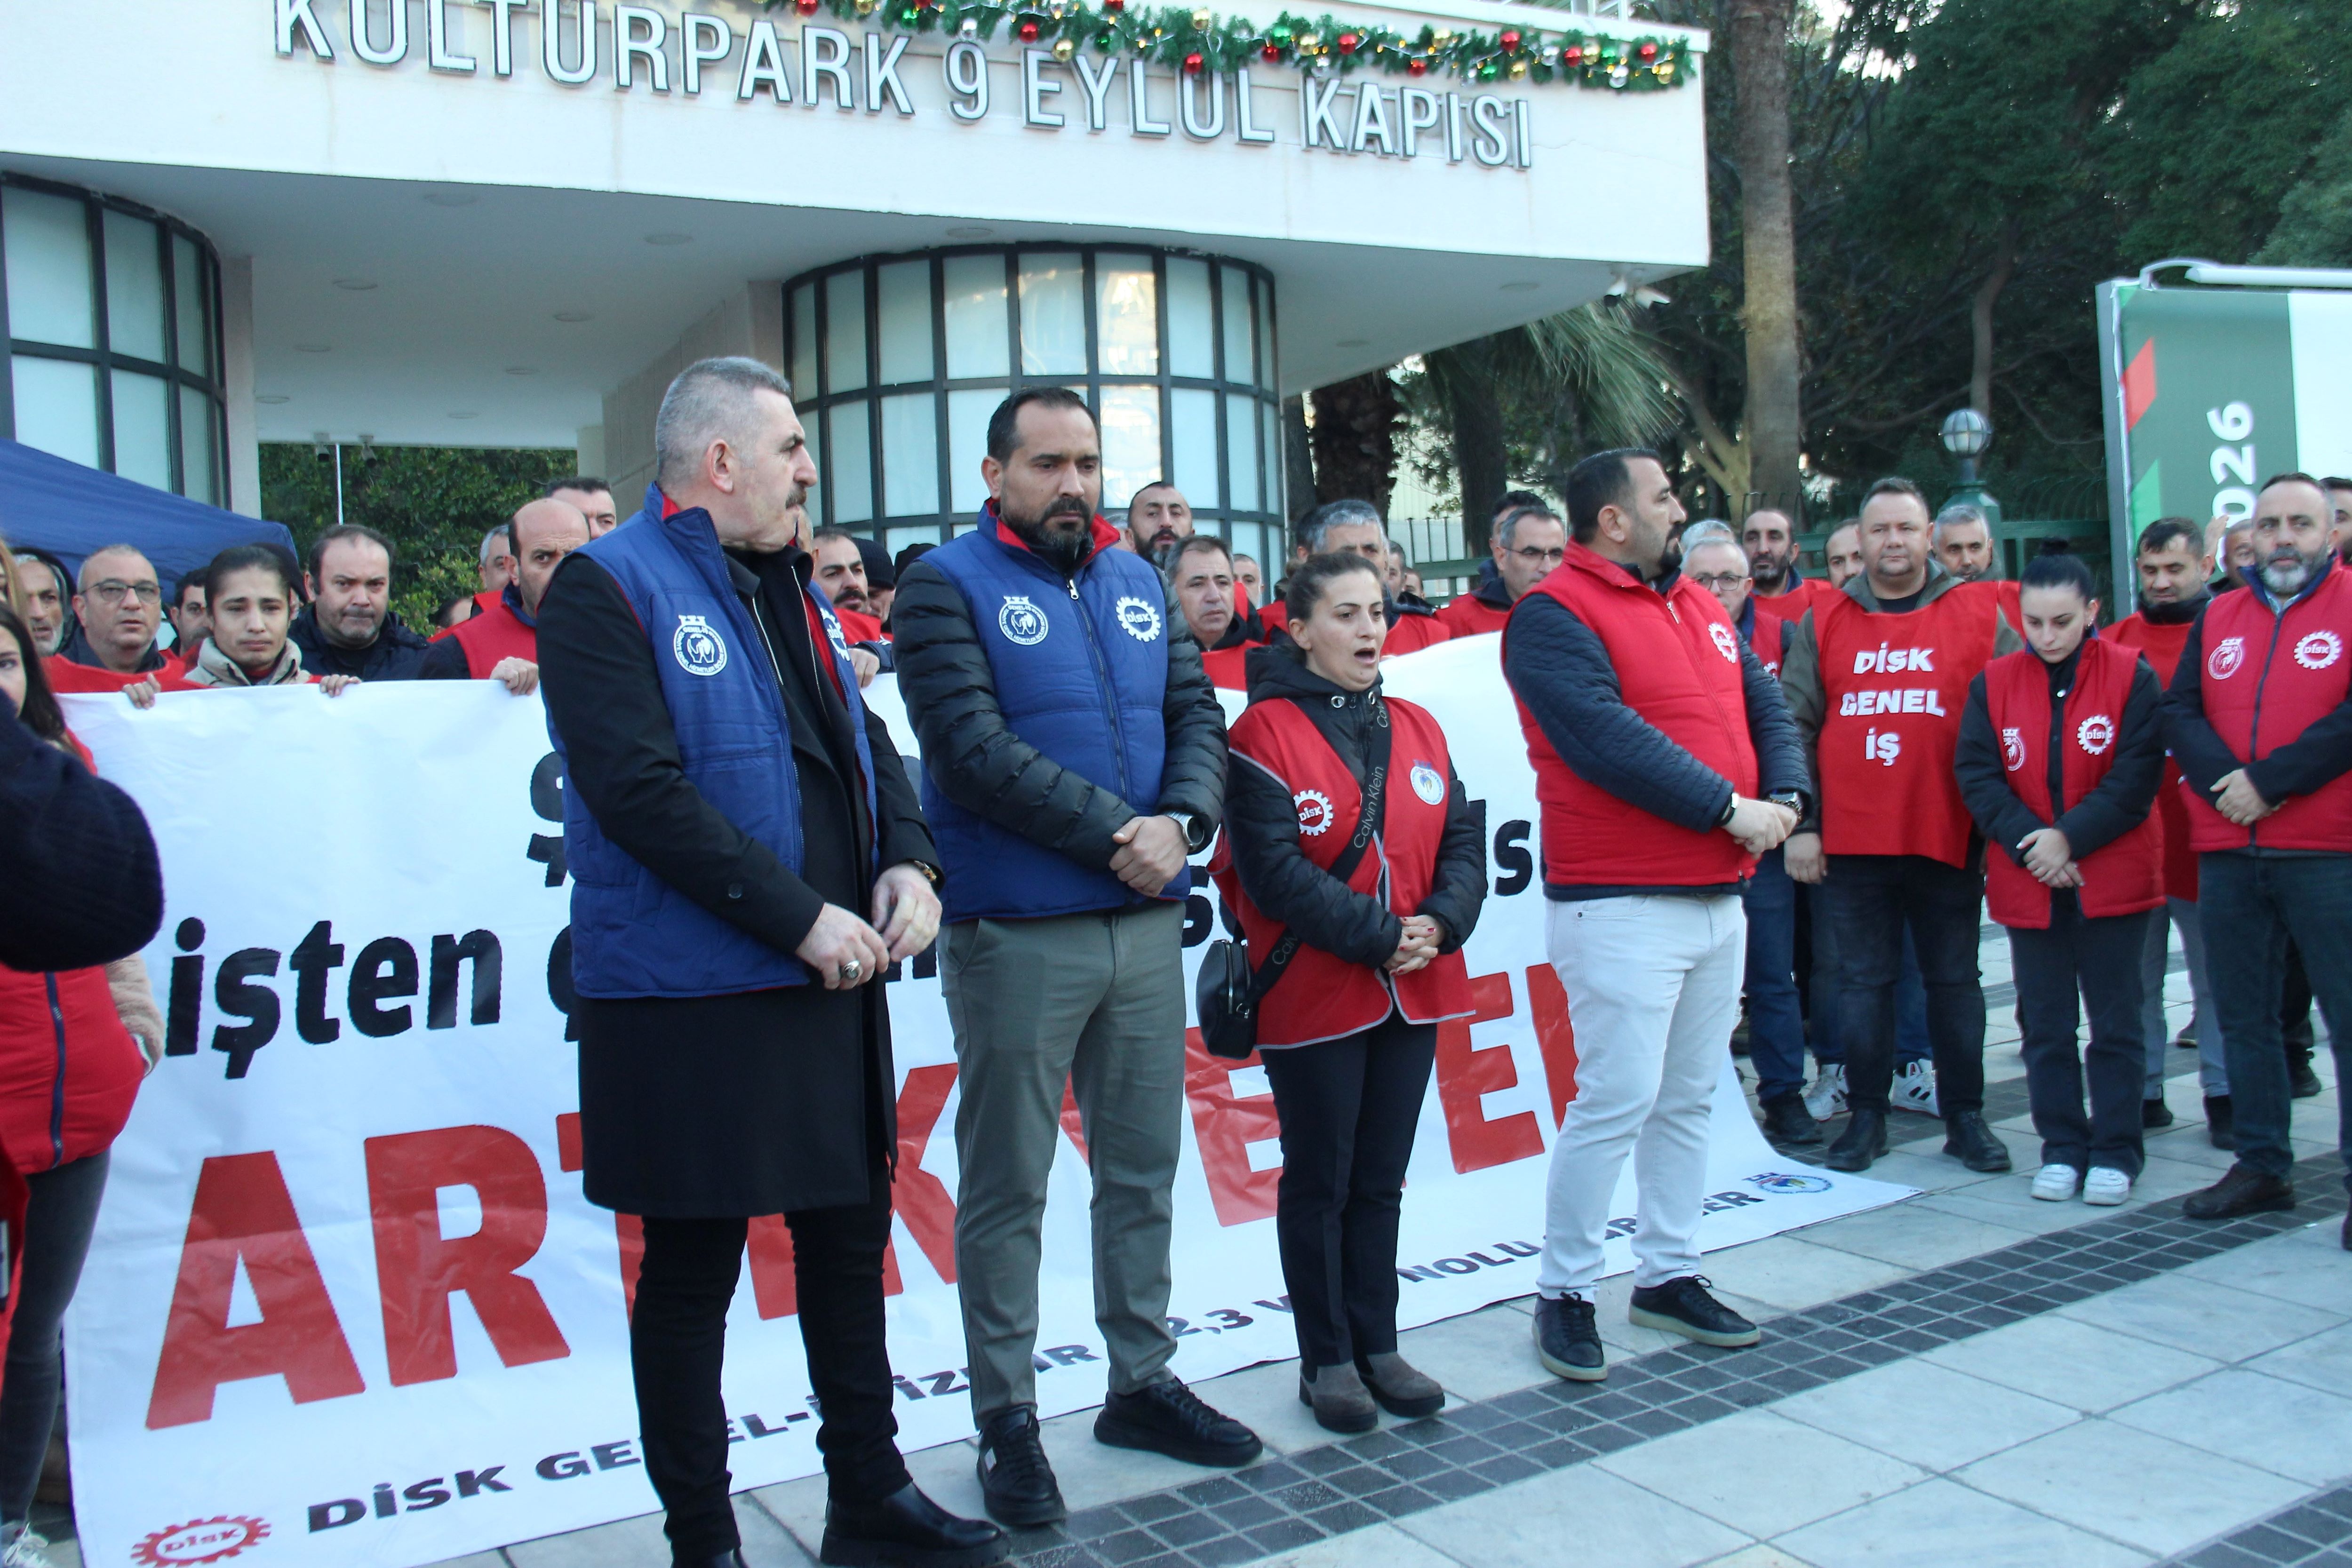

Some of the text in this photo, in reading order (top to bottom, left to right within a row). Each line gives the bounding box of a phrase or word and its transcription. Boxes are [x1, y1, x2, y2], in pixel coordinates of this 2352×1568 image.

[945, 41, 989, 125] 9
[1299, 74, 1531, 171] KAPISI
[2206, 402, 2256, 573] 026
[1853, 643, 1933, 674] DİSK
[2304, 643, 2329, 654] DİSK
[1840, 689, 1944, 717] GENEL
[1865, 728, 1900, 767] İŞ
[1299, 806, 1323, 821] DİSK
[1354, 766, 1384, 848] Calvin Klein
[165, 917, 502, 1079] işten
[308, 1465, 512, 1532] DİSK
[1396, 1241, 1542, 1282] NOLU
